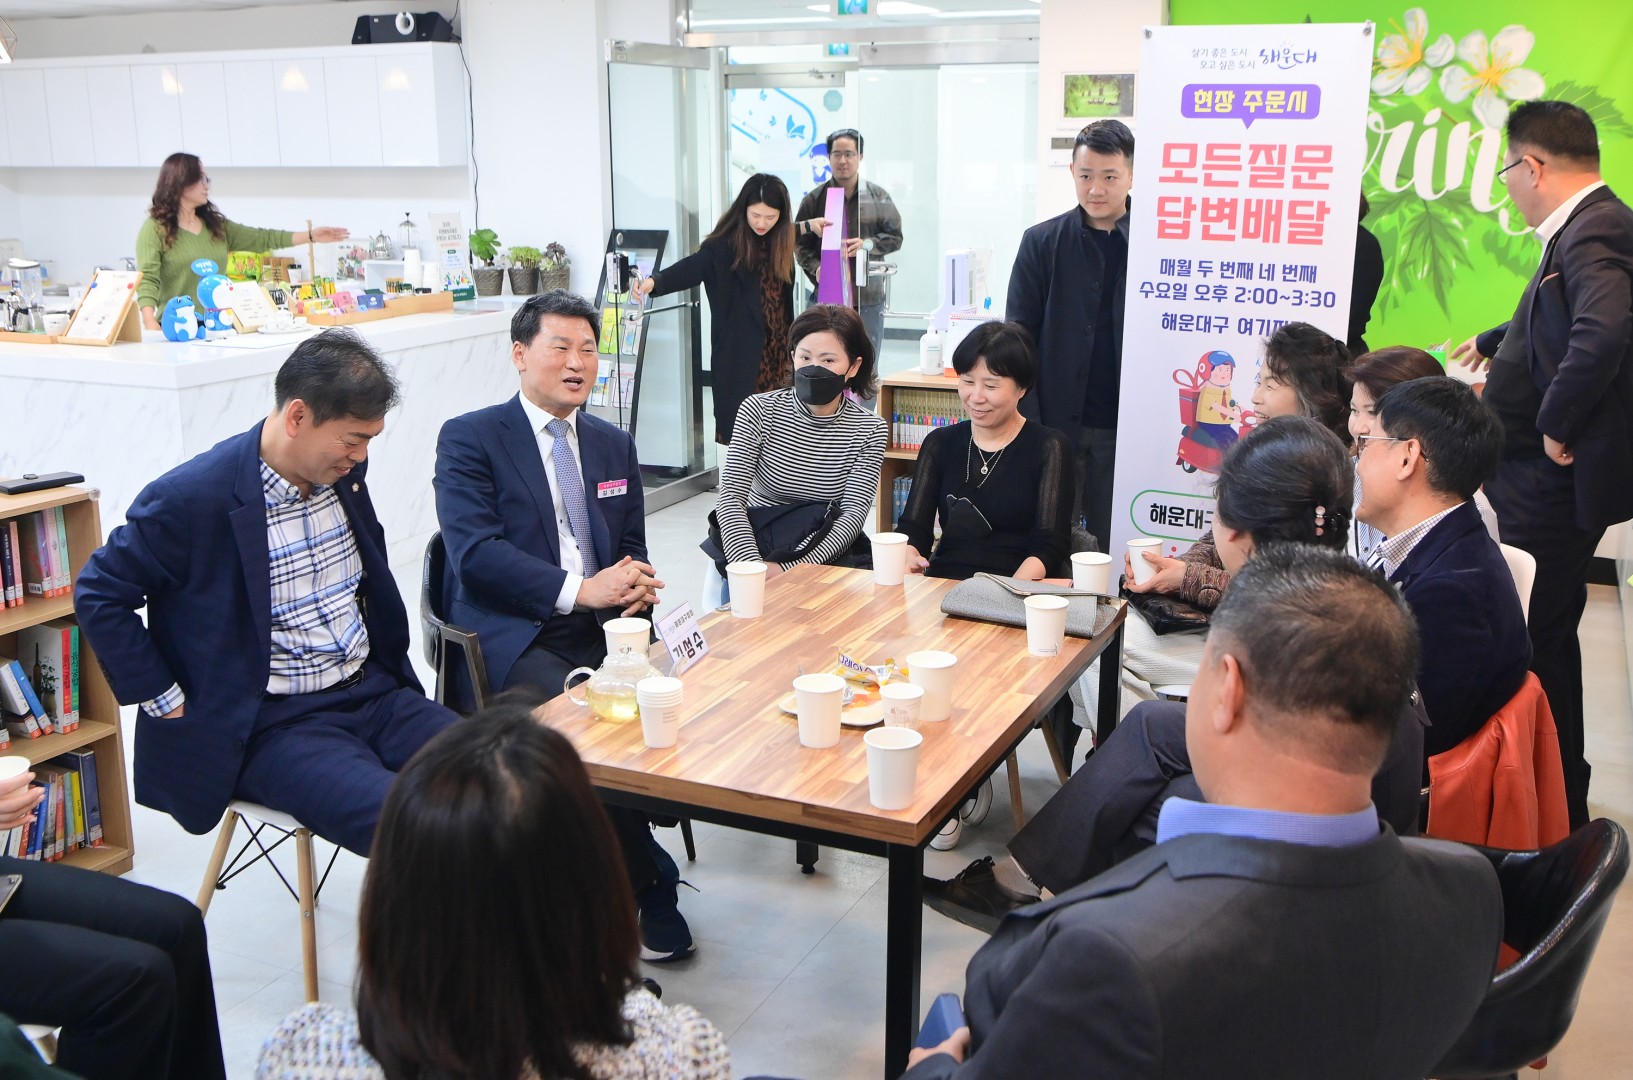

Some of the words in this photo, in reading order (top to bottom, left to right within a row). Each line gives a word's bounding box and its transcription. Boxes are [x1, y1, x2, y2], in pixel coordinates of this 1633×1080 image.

[1191, 48, 1209, 58] 살기
[1211, 48, 1228, 58] 좋은
[1231, 47, 1248, 57] 도시
[1258, 46, 1318, 70] 해운대
[1200, 60, 1216, 69] 오고
[1219, 60, 1235, 71] 싶은
[1239, 60, 1256, 69] 도시
[1193, 89, 1235, 113] 현장
[1243, 90, 1308, 114] 주문시
[1158, 142, 1334, 191] 모든질문
[1156, 196, 1331, 246] 답변배달
[1159, 258, 1192, 278] 매월
[1196, 260, 1214, 279] 두
[1219, 261, 1254, 281] 번째
[1258, 262, 1276, 282] 네
[1281, 263, 1318, 284] 번째
[1138, 281, 1188, 301] 수요일
[1193, 284, 1228, 303] 오후
[1234, 286, 1336, 309] 2:00~3:30
[1161, 311, 1230, 335] 해운대구
